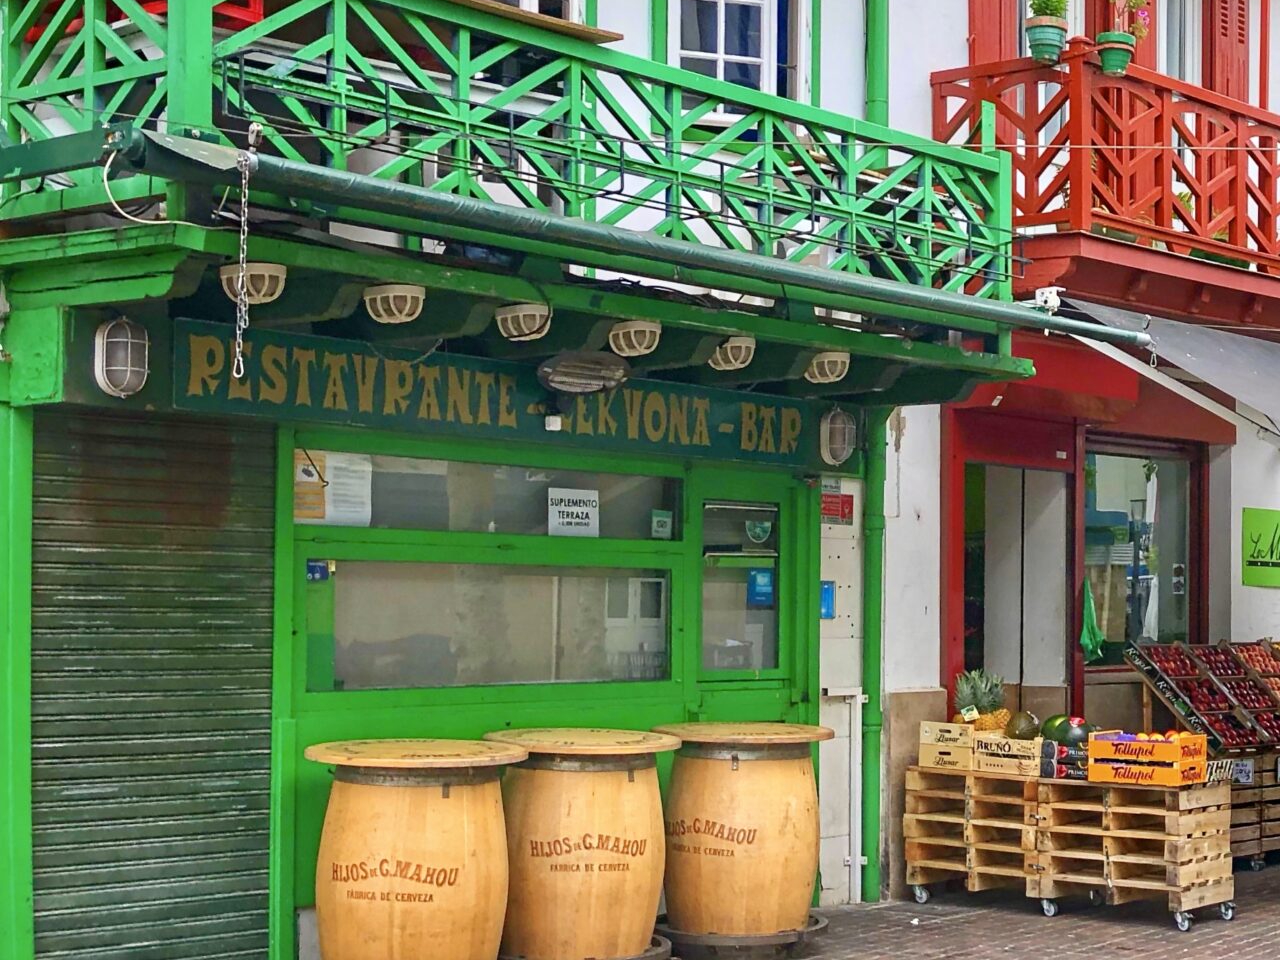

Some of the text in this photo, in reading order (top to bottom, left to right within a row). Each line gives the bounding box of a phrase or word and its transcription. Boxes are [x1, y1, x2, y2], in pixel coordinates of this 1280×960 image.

[740, 401, 802, 455] BAR
[550, 497, 598, 509] SUPLEMENTO
[558, 510, 591, 520] TERRAZA
[1157, 680, 1177, 702] Roya
[530, 837, 573, 857] HIJOS
[704, 847, 735, 857] CERVEZA
[332, 861, 369, 882] HIJOS
[585, 863, 594, 872] DE
[598, 863, 630, 872] CERVEZA
[380, 892, 390, 901] DE
[395, 892, 434, 902] CERVEZA
